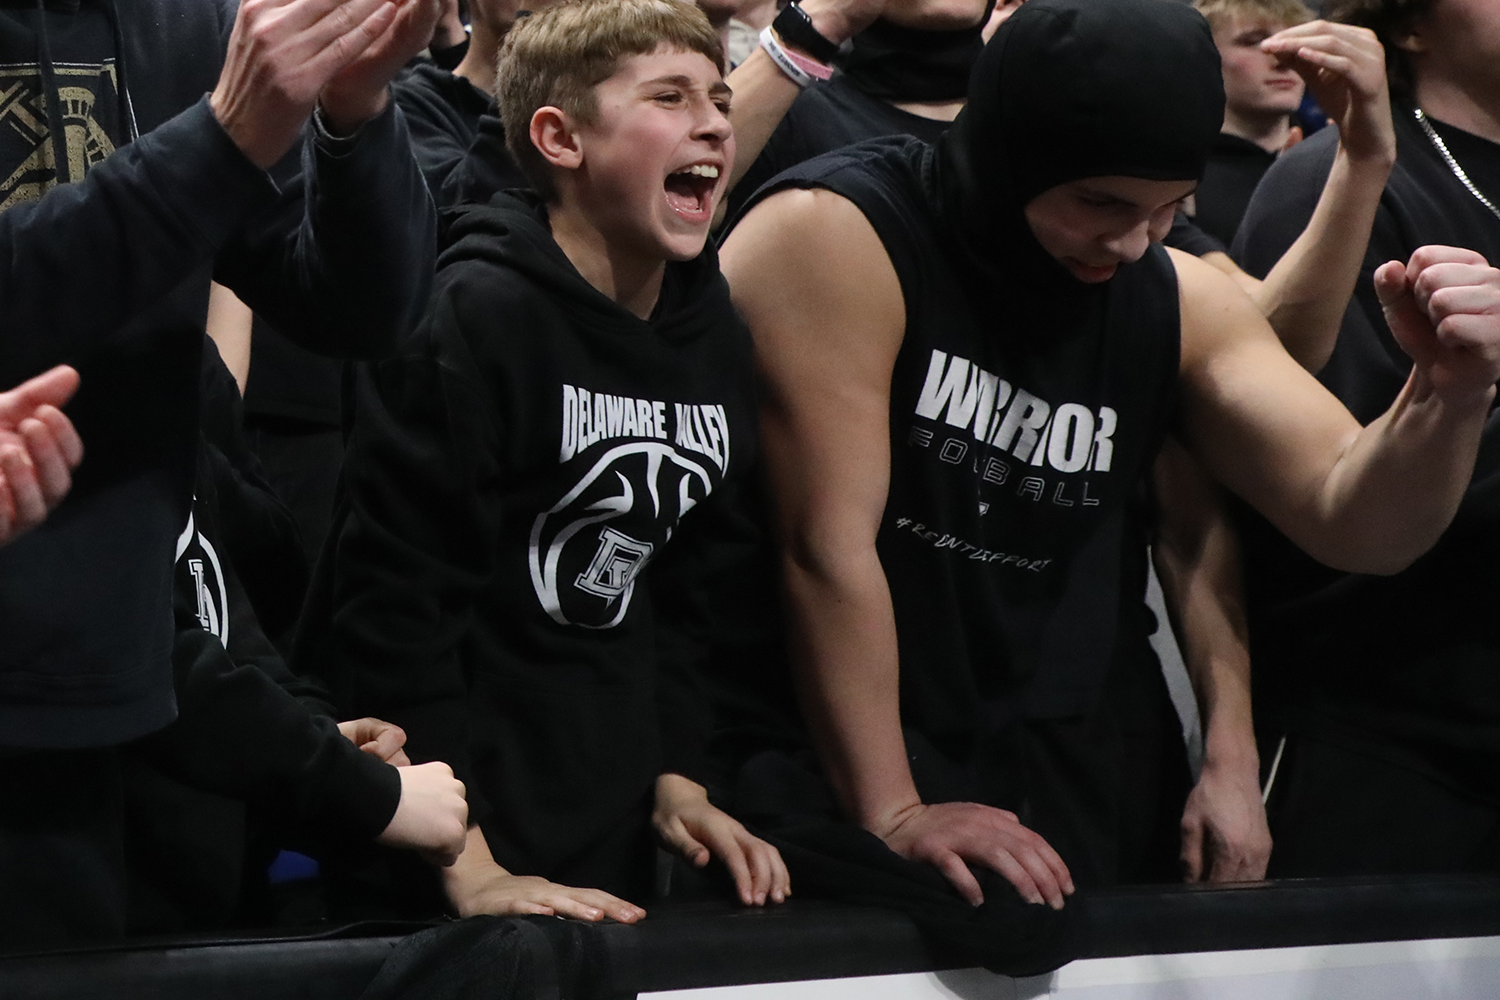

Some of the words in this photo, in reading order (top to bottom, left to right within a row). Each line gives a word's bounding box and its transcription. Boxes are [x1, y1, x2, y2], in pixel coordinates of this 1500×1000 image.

[559, 384, 668, 464] DELAWARE
[915, 348, 1118, 474] WRRIOR
[908, 425, 1100, 507] FOBALL
